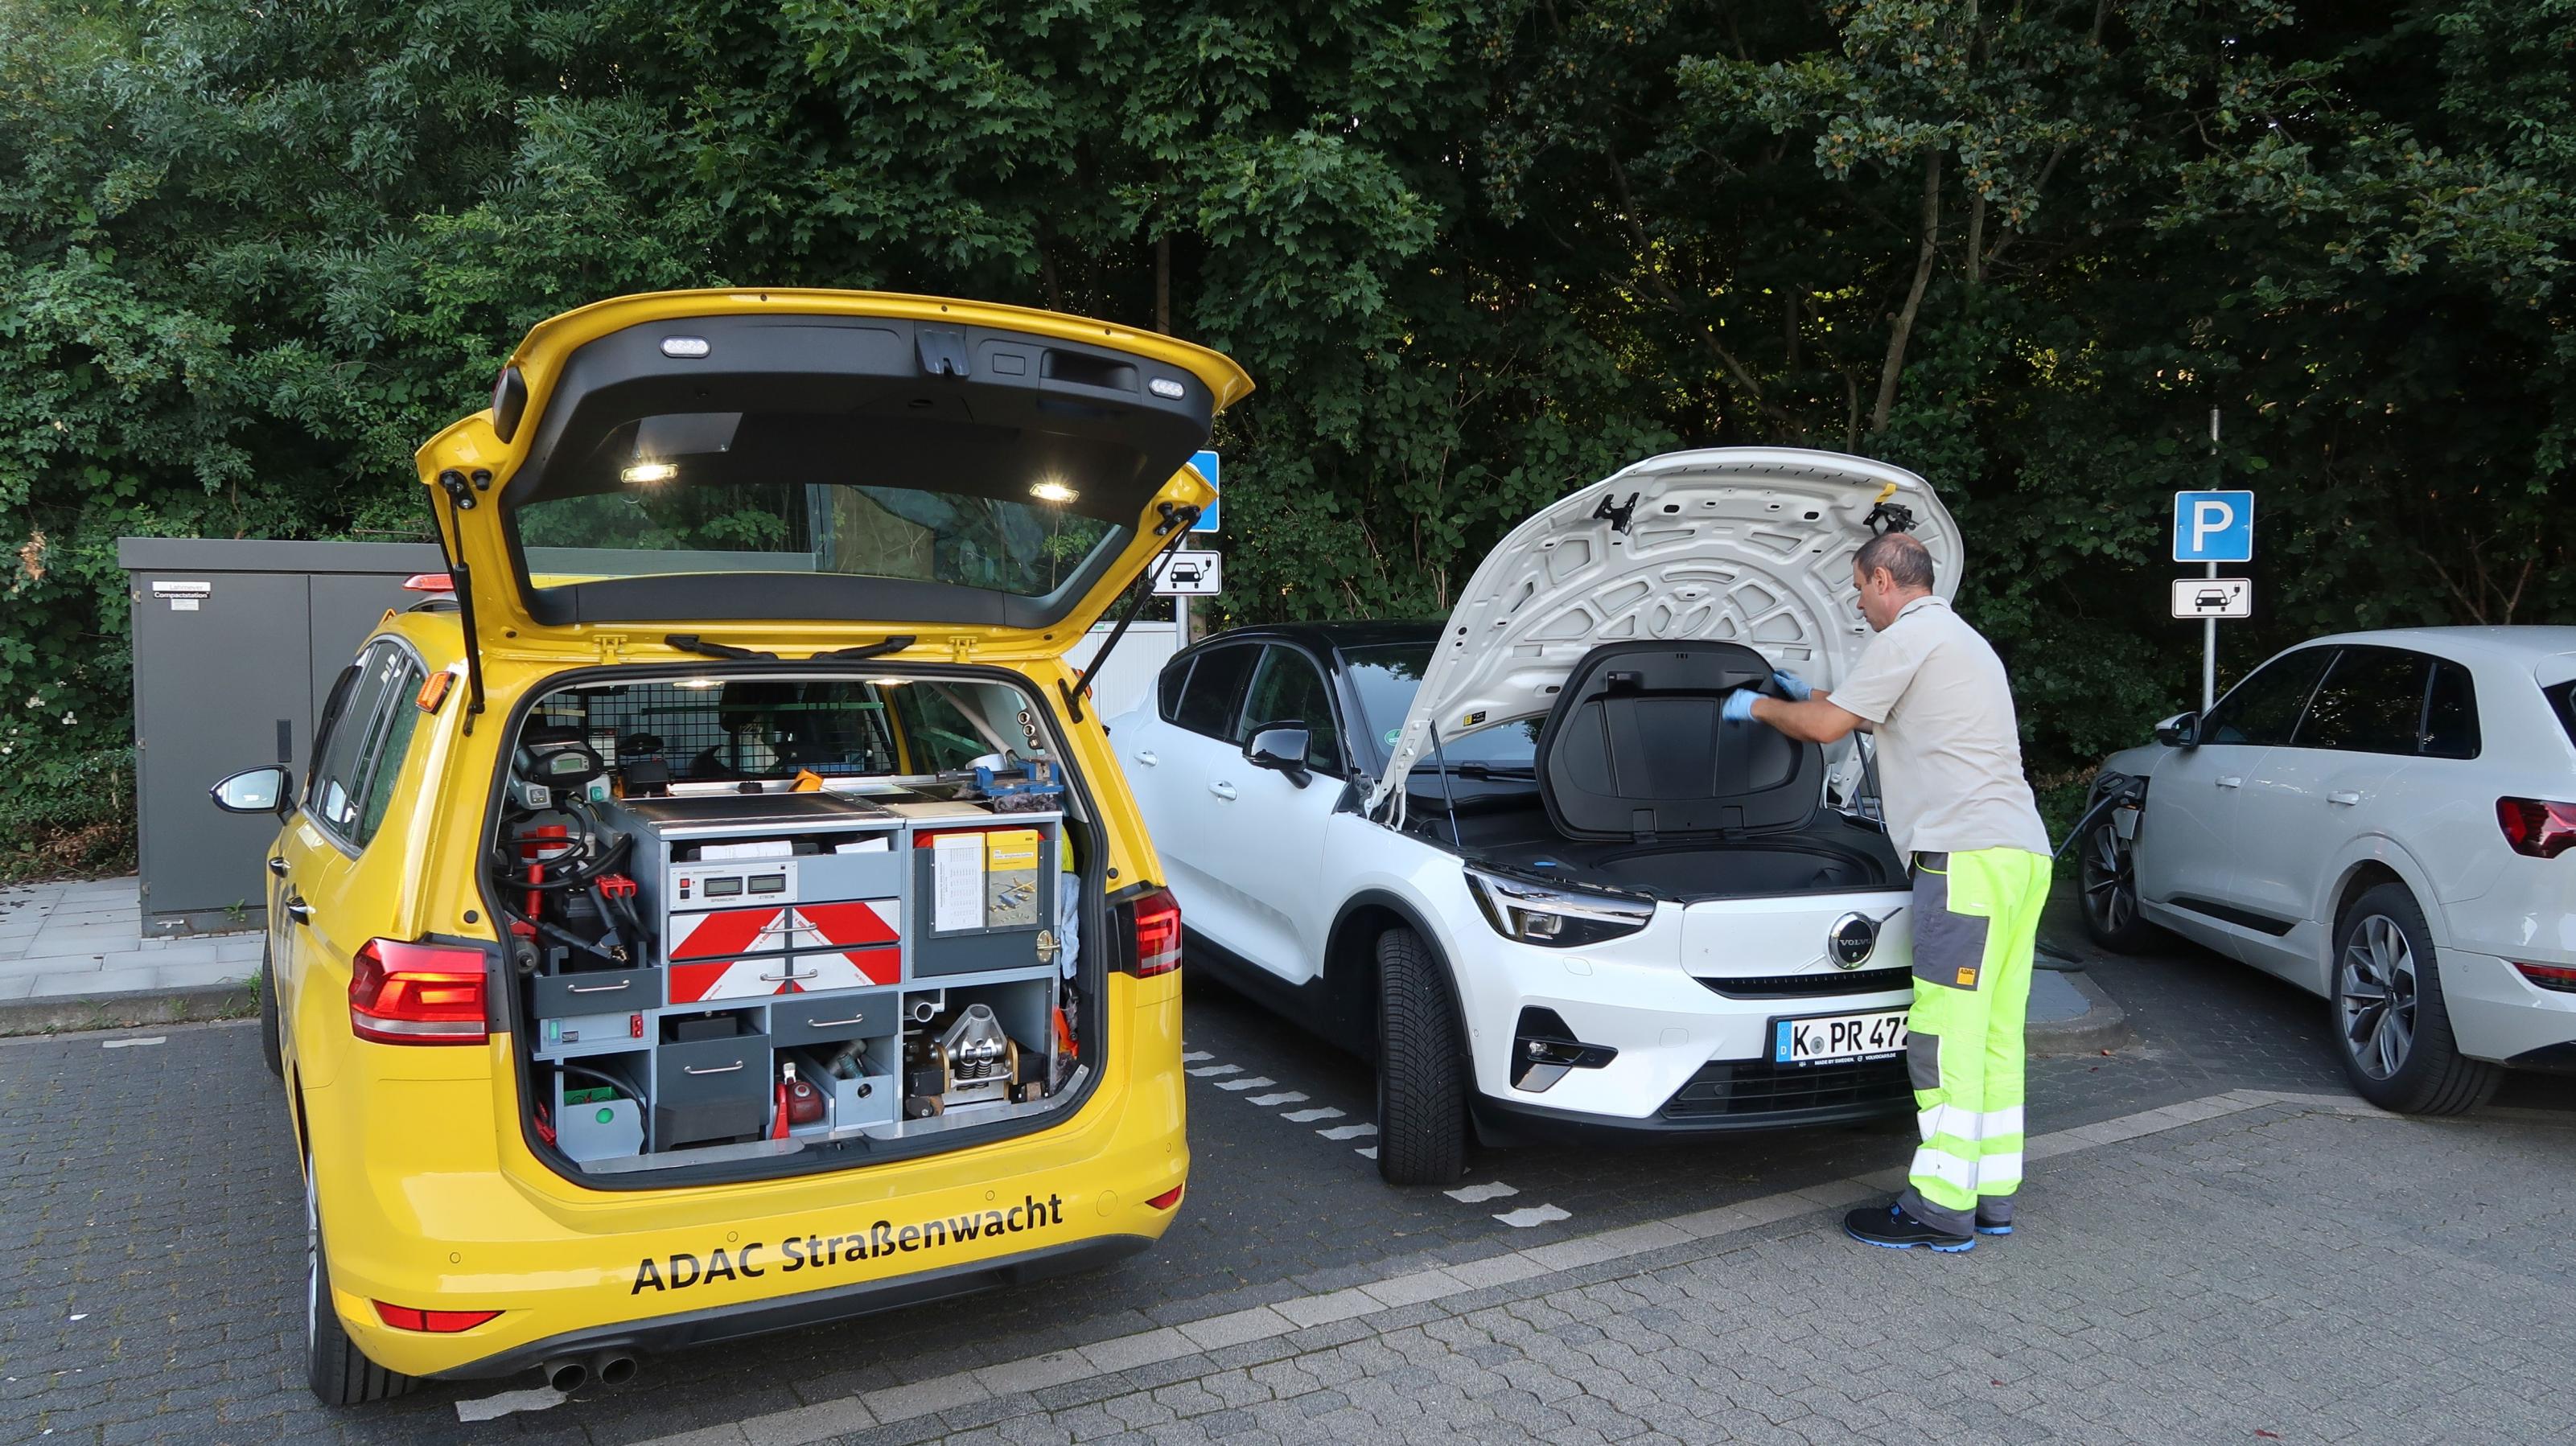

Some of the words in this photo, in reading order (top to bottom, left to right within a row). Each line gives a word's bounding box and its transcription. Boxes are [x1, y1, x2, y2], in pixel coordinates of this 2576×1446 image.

[2193, 500, 2234, 552] P
[1839, 938, 1872, 947] VOLVO
[1960, 967, 1976, 976] ADAC
[1780, 1045, 1787, 1055] D
[1793, 1025, 1811, 1057] K
[1830, 1020, 1863, 1054] PR
[631, 1243, 765, 1296] ADAC
[781, 1193, 1064, 1272] Straßenwacht
